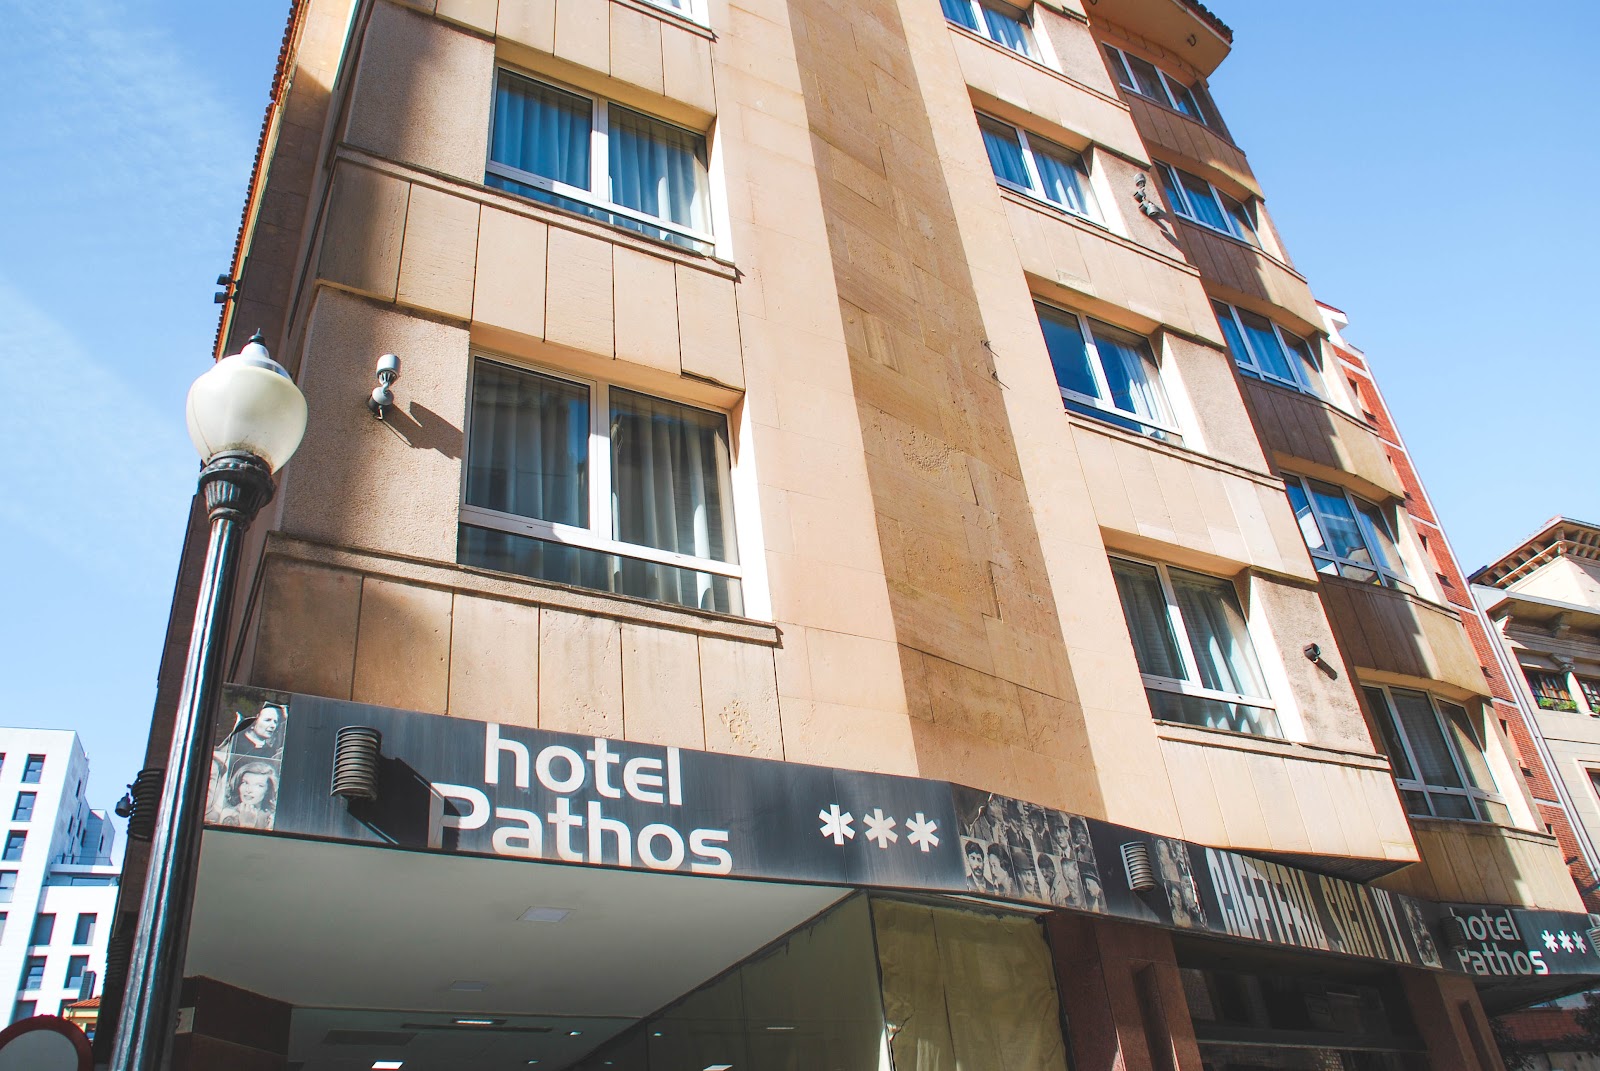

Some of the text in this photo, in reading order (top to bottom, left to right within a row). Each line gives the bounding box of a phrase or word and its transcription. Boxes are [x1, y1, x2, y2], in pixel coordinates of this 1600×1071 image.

[485, 723, 683, 806] hotel
[428, 782, 733, 876] Pathos
[1370, 886, 1411, 964] XX
